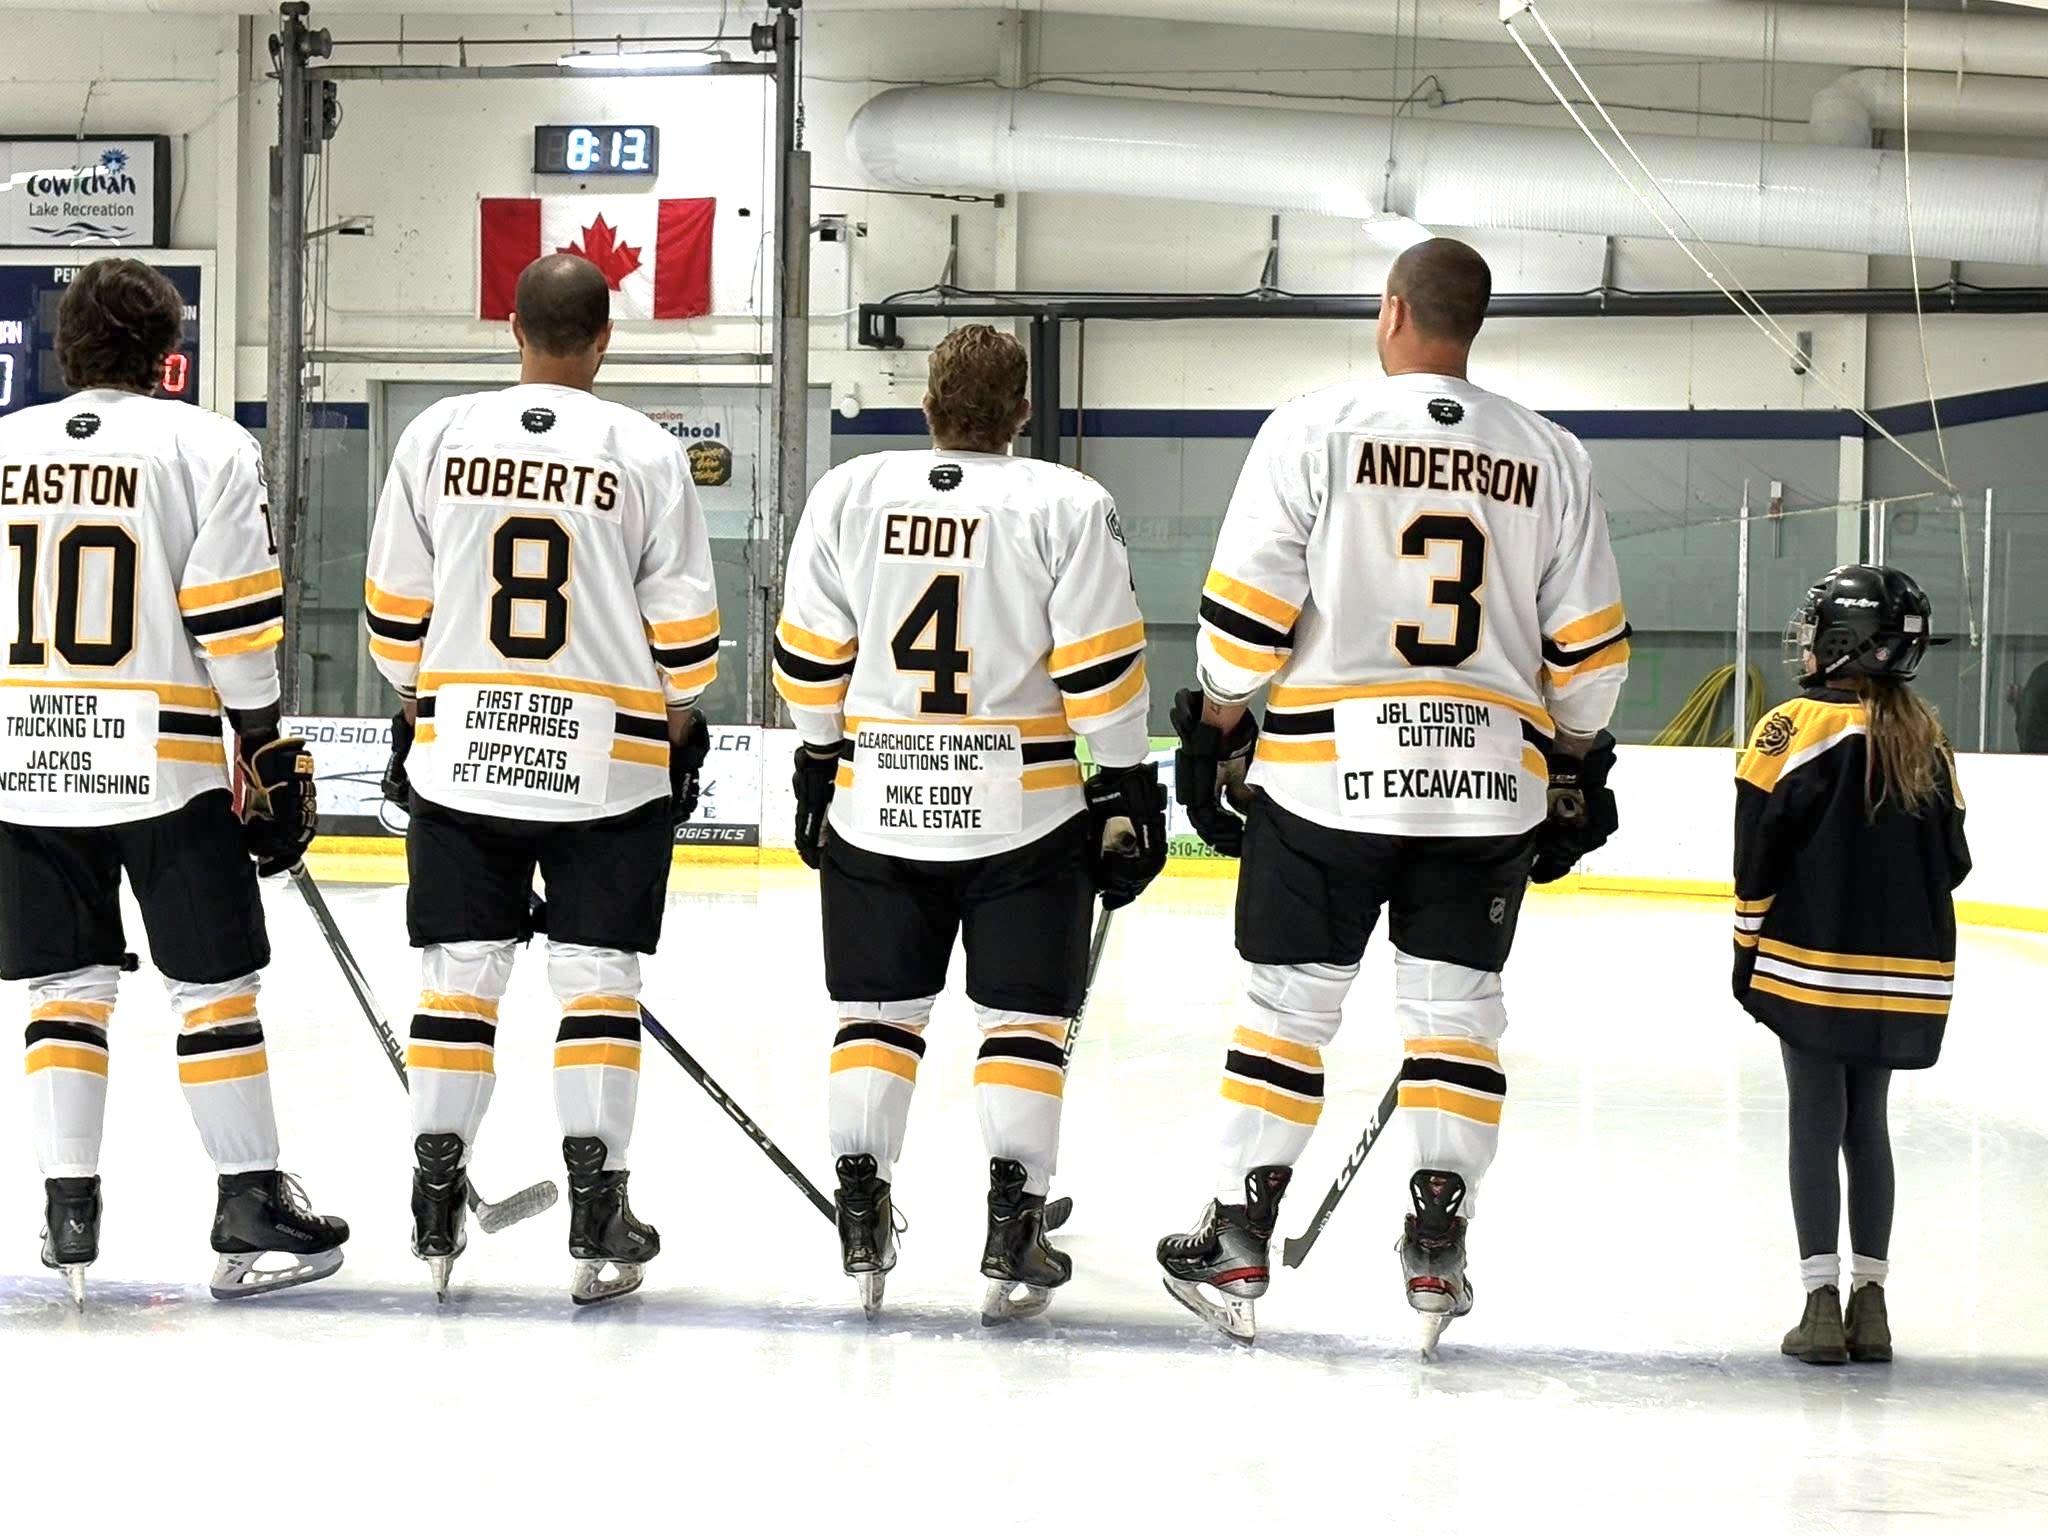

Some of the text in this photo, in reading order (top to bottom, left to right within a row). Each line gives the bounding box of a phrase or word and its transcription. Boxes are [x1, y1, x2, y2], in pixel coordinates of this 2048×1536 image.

[566, 128, 649, 171] 8:13
[29, 202, 134, 217] Lake Recreation
[646, 409, 683, 421] eation
[1, 463, 138, 508] EASTON
[443, 457, 619, 512] ROBERTS
[1355, 441, 1540, 509] ANDERSON
[884, 513, 981, 560] EDDY
[7, 522, 139, 668] 10
[488, 514, 571, 662] 8
[1393, 513, 1487, 668] 3
[890, 573, 970, 716] 4
[29, 694, 98, 717] WINTER
[476, 690, 573, 717] FIRST STOP
[1376, 702, 1491, 727] J&L CUSTOM
[6, 716, 125, 740] TRUCKING LTD
[289, 726, 392, 744] 250.510.0
[465, 710, 580, 740] ENTERPRISES
[1398, 724, 1476, 748] CUTTING
[709, 734, 751, 751] .CA
[858, 731, 1016, 752] CLEARCHOICE FINANCIAL
[26, 750, 92, 771] JACKOS
[468, 741, 568, 770] PUPPYCATS
[878, 752, 984, 772] SOLUTIONS INC.
[0, 771, 150, 796] NCRETE FINISHING
[452, 763, 580, 795] PET EMPORIUM
[1344, 768, 1518, 804] CT EXCAVATING
[886, 784, 974, 806] MIKE EDDY
[879, 807, 982, 830] REAL ESTATE
[675, 828, 746, 840] OGISTICS
[1169, 842, 1224, 857] 510-75
